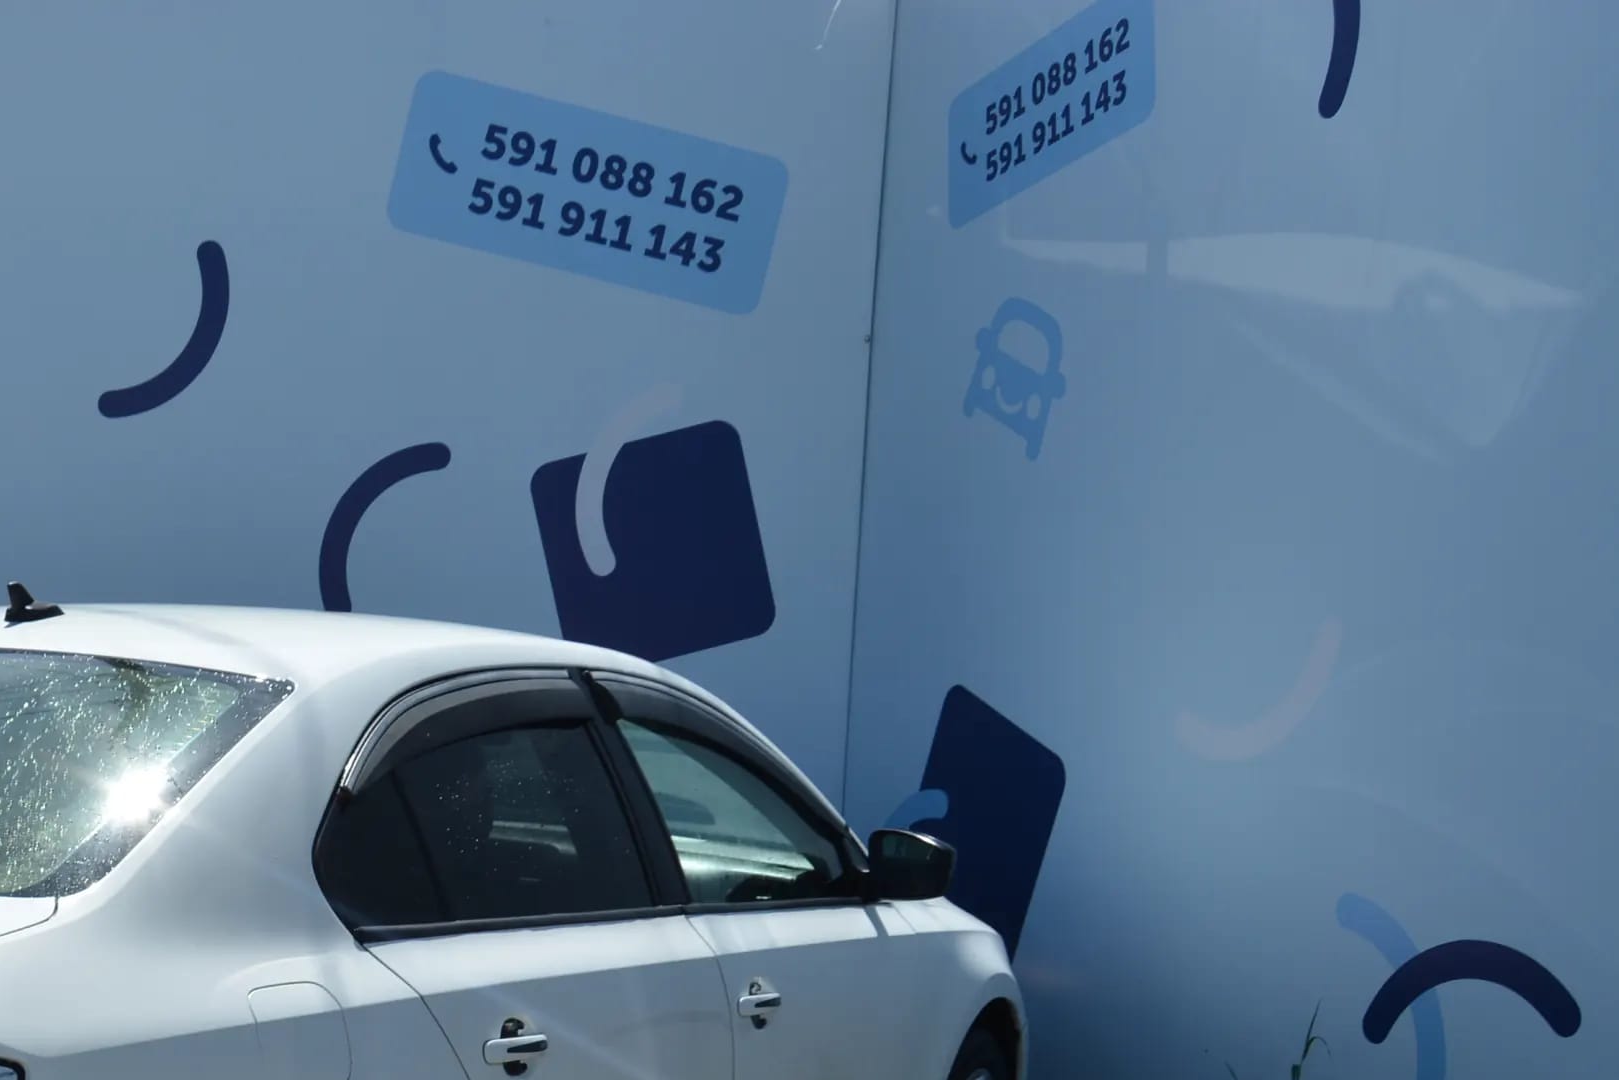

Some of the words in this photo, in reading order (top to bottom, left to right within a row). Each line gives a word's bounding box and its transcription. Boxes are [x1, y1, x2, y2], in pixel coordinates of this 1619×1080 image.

[985, 85, 1027, 136] 591
[1031, 51, 1077, 106] 088
[1084, 17, 1131, 75] 162
[985, 132, 1027, 182] 591
[1032, 102, 1075, 155] 911
[1081, 68, 1127, 127] 143
[467, 177, 546, 230] 591
[557, 200, 633, 252] 911
[643, 223, 726, 273] 143
[480, 123, 558, 176] 591
[571, 147, 656, 199] 088
[663, 171, 744, 223] 162
